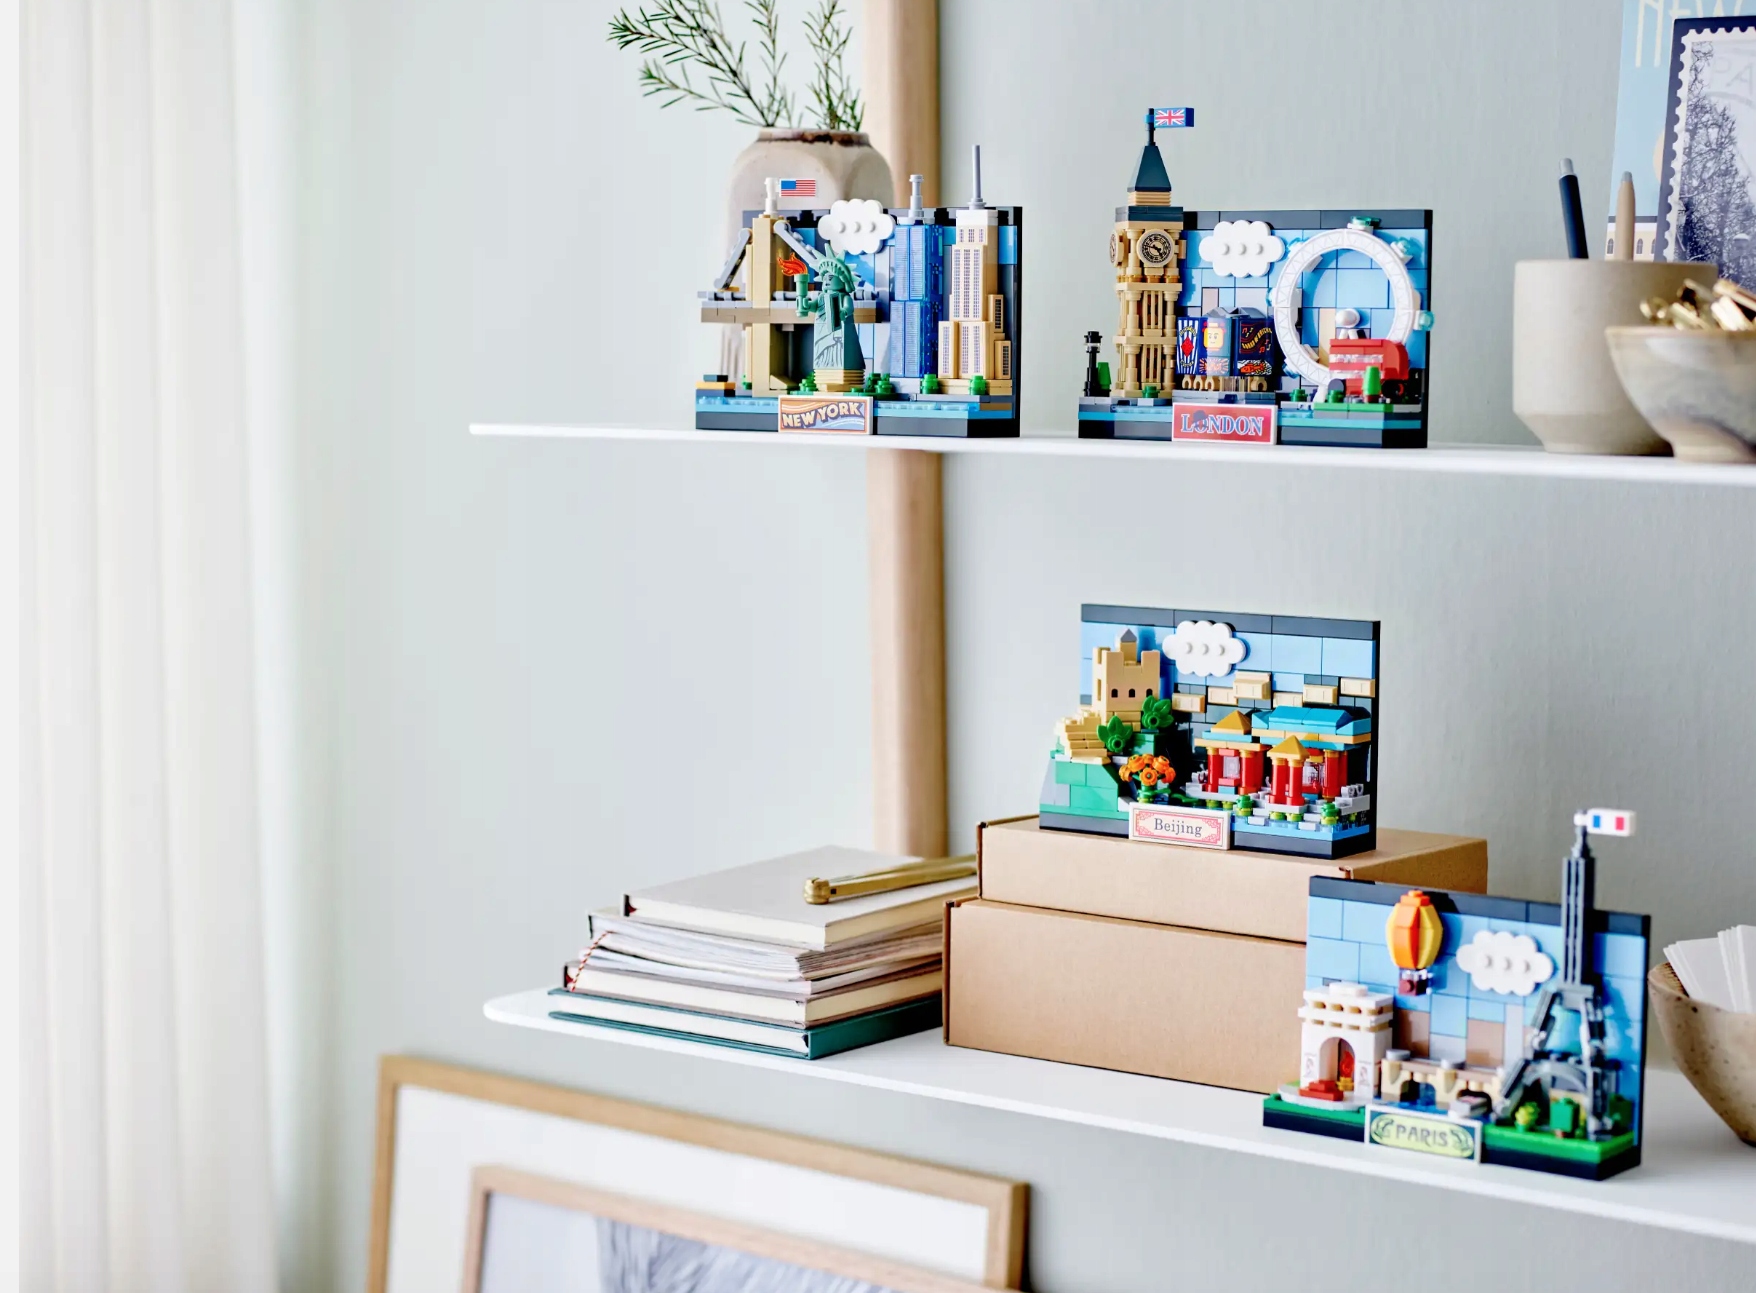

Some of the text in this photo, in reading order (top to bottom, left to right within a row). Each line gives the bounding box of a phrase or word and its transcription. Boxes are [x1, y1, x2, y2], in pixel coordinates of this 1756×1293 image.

[782, 402, 862, 429] NEW YORK
[1181, 412, 1264, 436] LONDON
[1154, 818, 1203, 837] Beijing
[1395, 1124, 1449, 1148] PARIS
